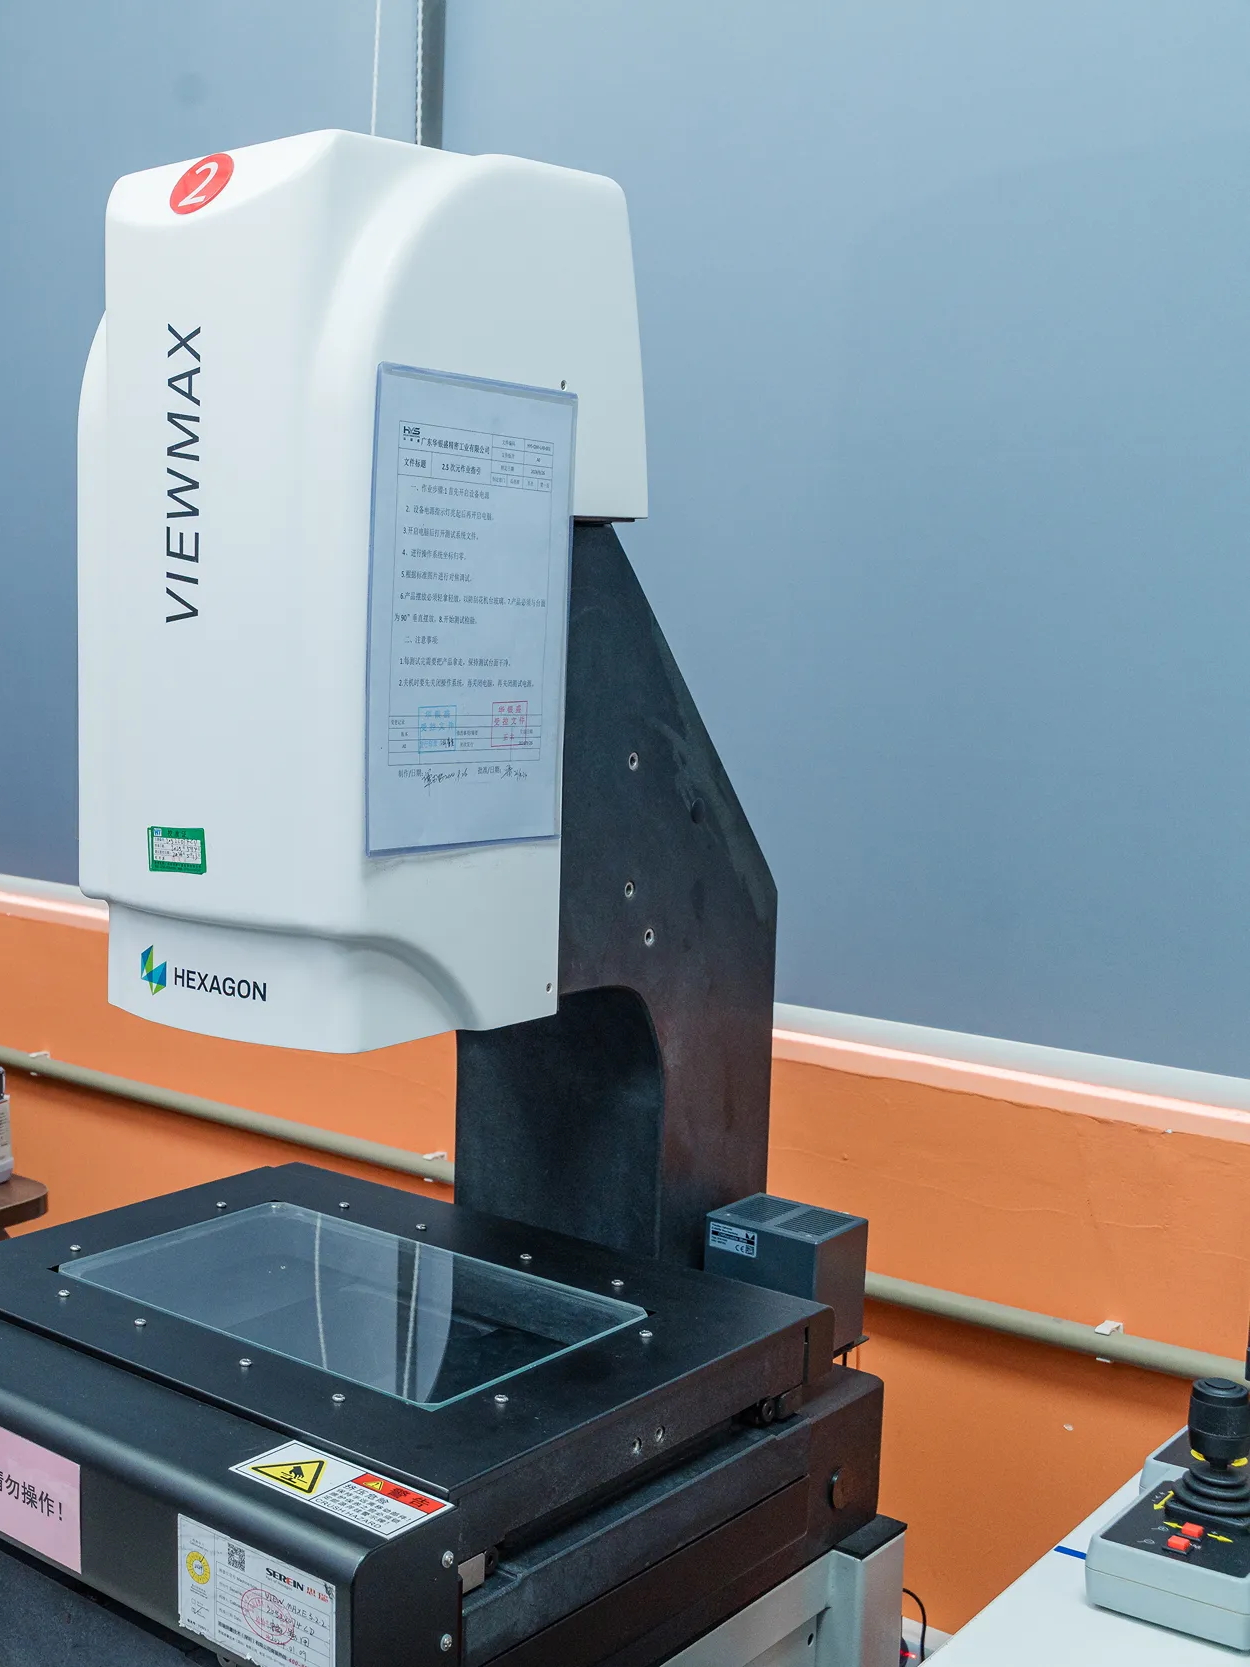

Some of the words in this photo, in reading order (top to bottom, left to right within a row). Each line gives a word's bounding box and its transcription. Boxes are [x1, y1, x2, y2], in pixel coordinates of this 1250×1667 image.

[177, 161, 220, 207] 2
[166, 323, 201, 623] VIEWMAX
[404, 458, 426, 468] 文件标题
[174, 967, 267, 1002] HEXAGON
[316, 1498, 346, 1512] CRUSH
[345, 1511, 382, 1528] HAZARD
[266, 1568, 304, 1591] SEREIN
